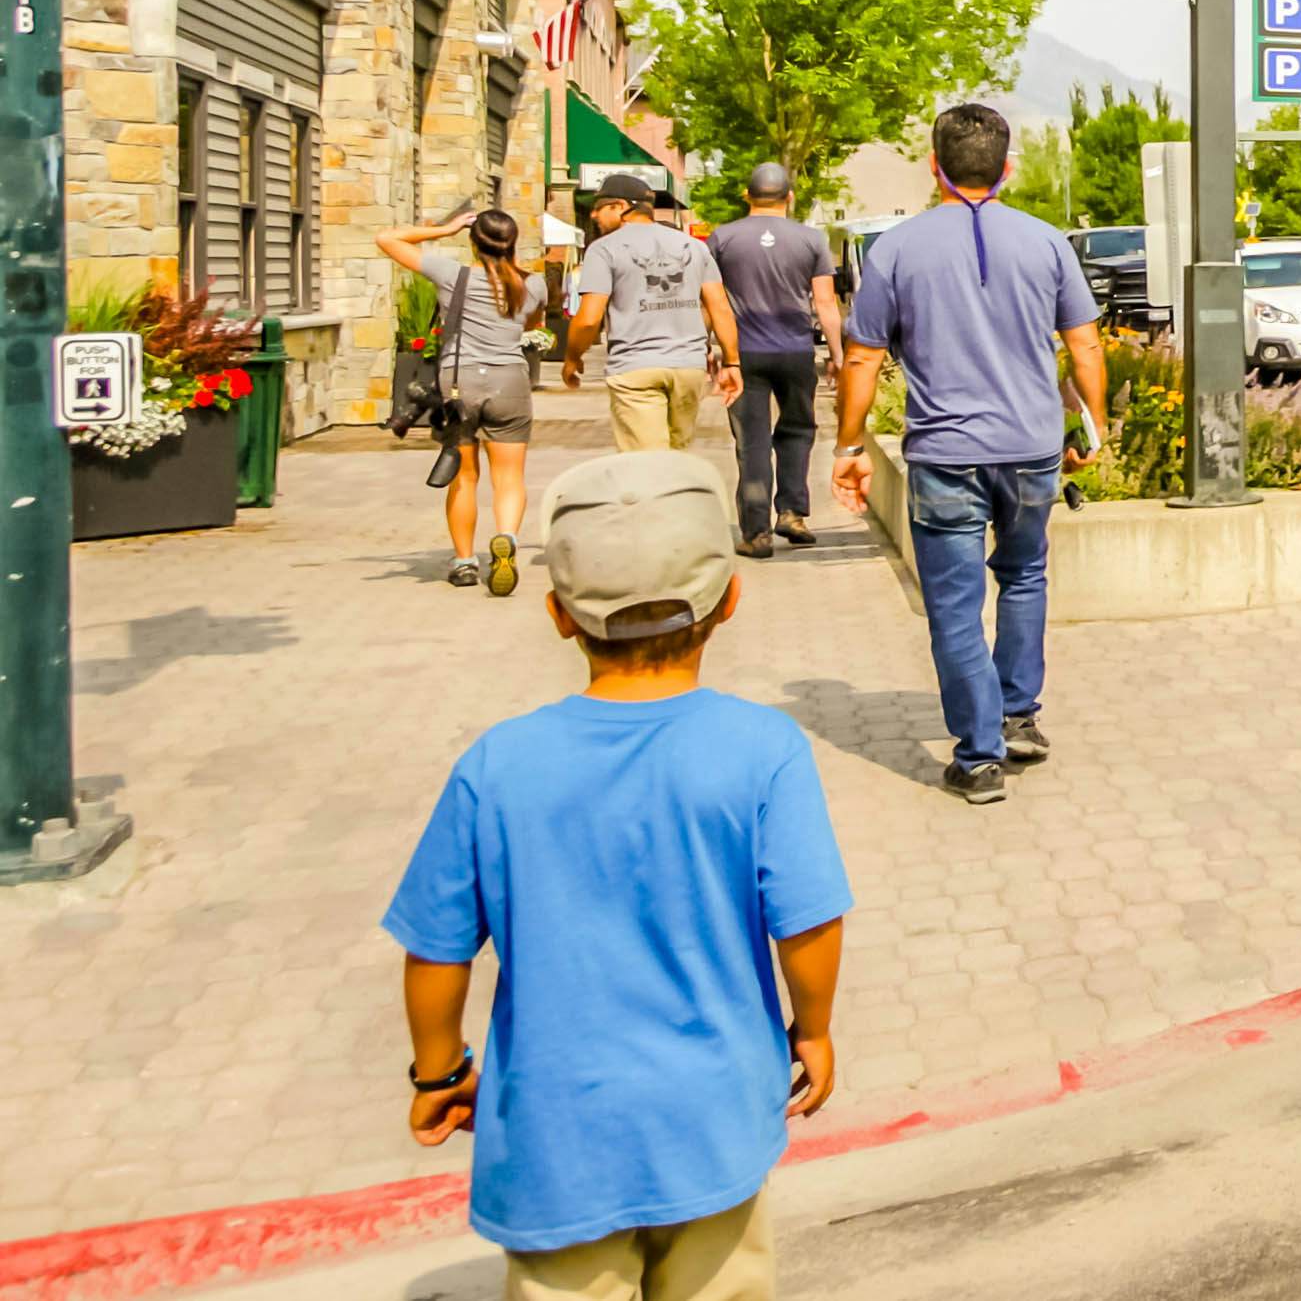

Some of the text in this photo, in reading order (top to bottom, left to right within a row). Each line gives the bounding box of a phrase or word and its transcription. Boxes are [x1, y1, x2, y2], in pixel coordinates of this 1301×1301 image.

[75, 346, 110, 355] PUSH
[66, 356, 119, 366] BUTTON
[79, 366, 105, 375] FOR
